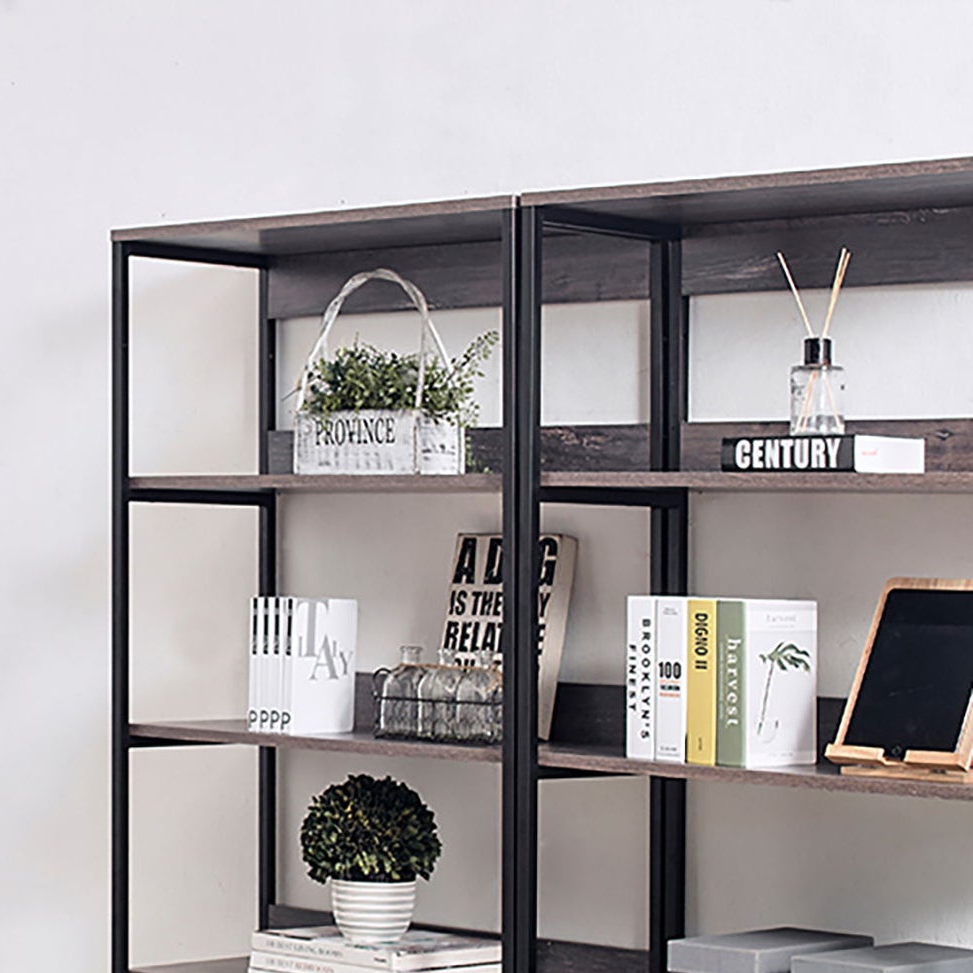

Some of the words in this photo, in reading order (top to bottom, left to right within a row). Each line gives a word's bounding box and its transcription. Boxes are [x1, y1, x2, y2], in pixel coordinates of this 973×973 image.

[315, 417, 396, 446] PROVINCE
[735, 438, 841, 469] CENTURY
[452, 537, 477, 584] A
[484, 537, 558, 586] DG
[449, 590, 467, 615] IS
[471, 591, 504, 616] THE
[658, 661, 682, 679] 100
[727, 638, 742, 725] harvest
